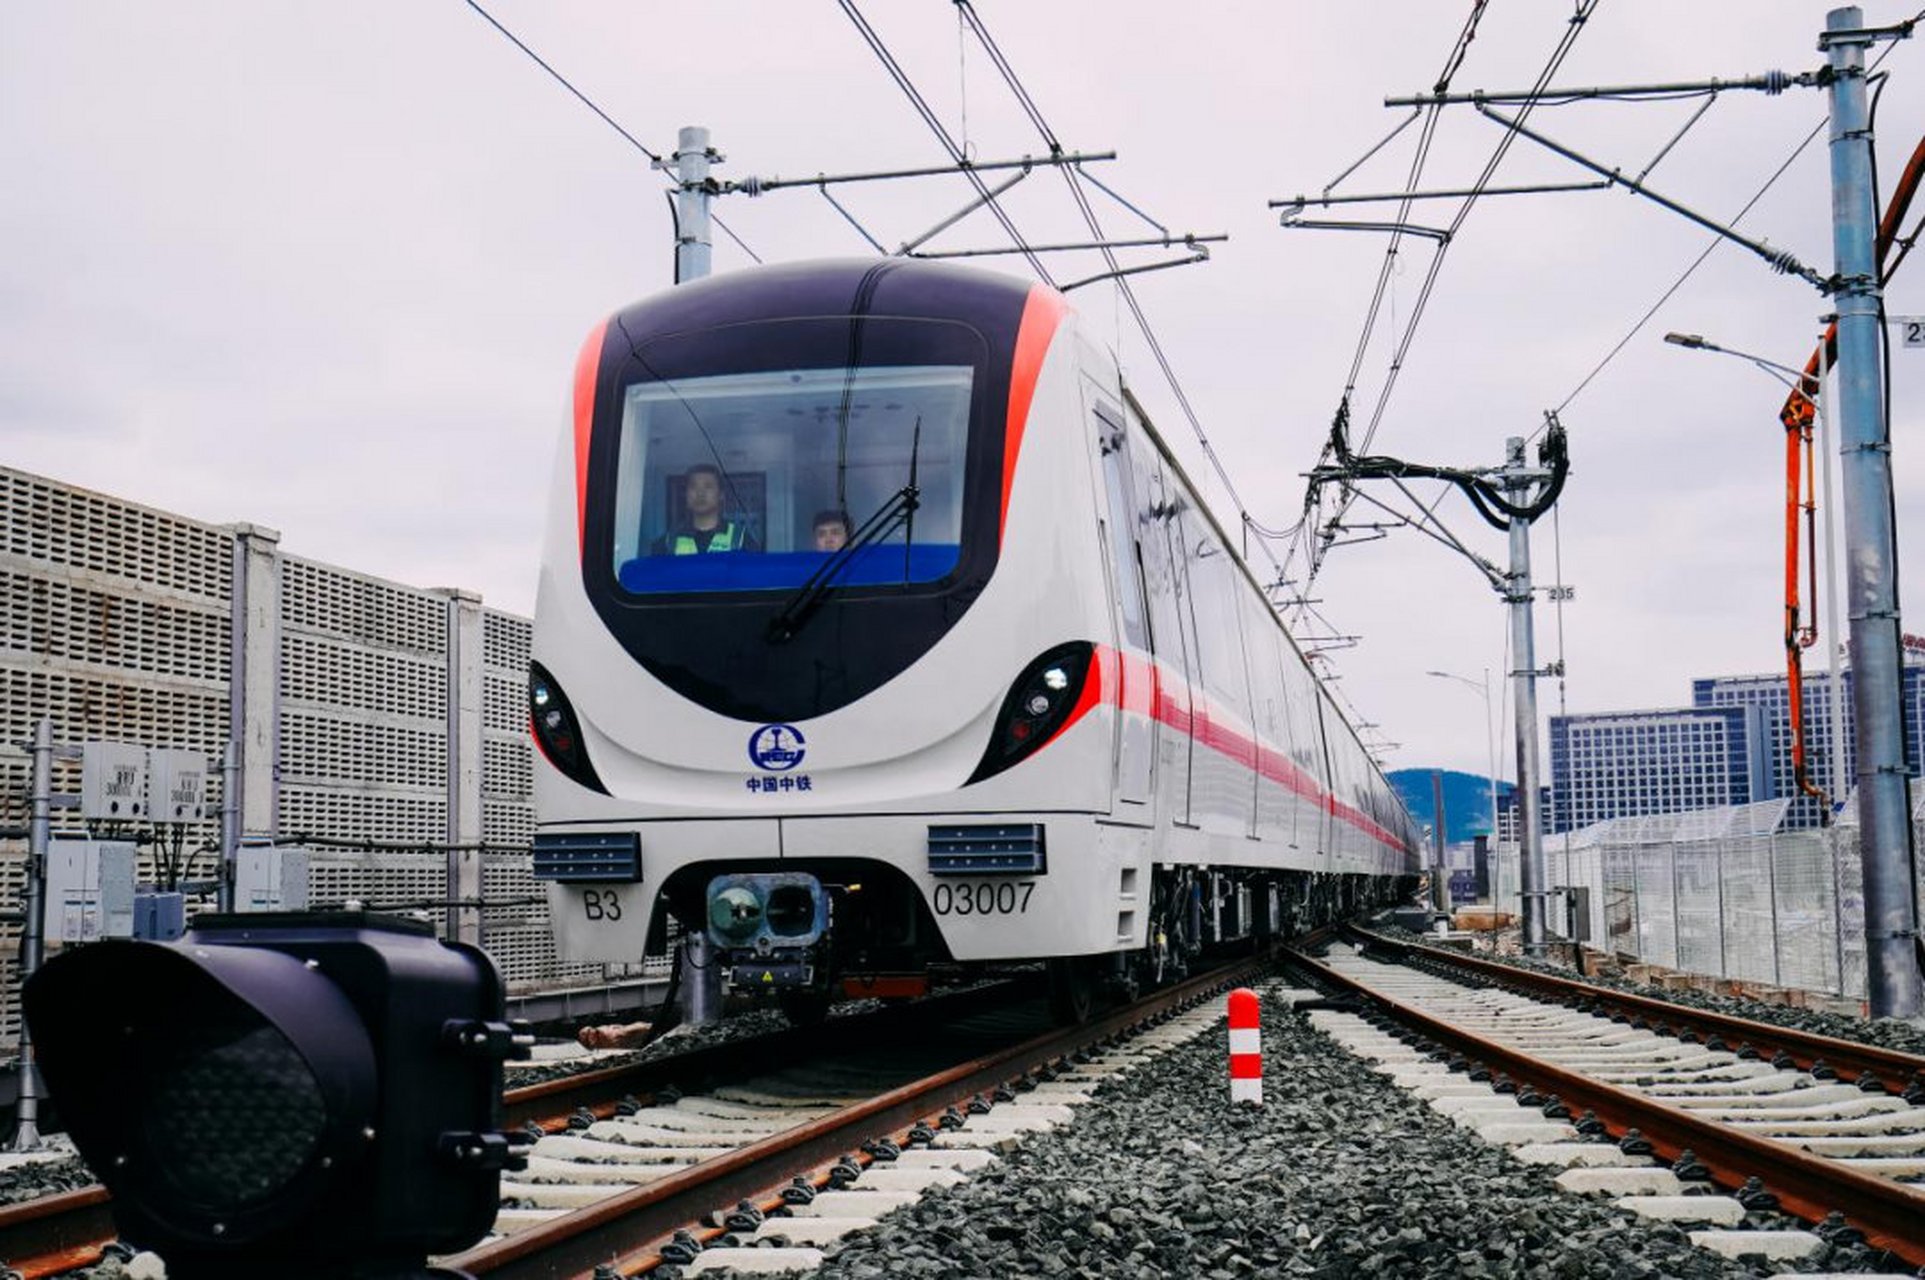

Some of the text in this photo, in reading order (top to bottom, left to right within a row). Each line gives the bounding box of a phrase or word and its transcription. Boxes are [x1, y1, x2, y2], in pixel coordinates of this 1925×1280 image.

[1908, 323, 1925, 342] 2
[746, 775, 812, 792] 中国中铁
[584, 890, 621, 921] B3
[934, 882, 1035, 915] 03007
